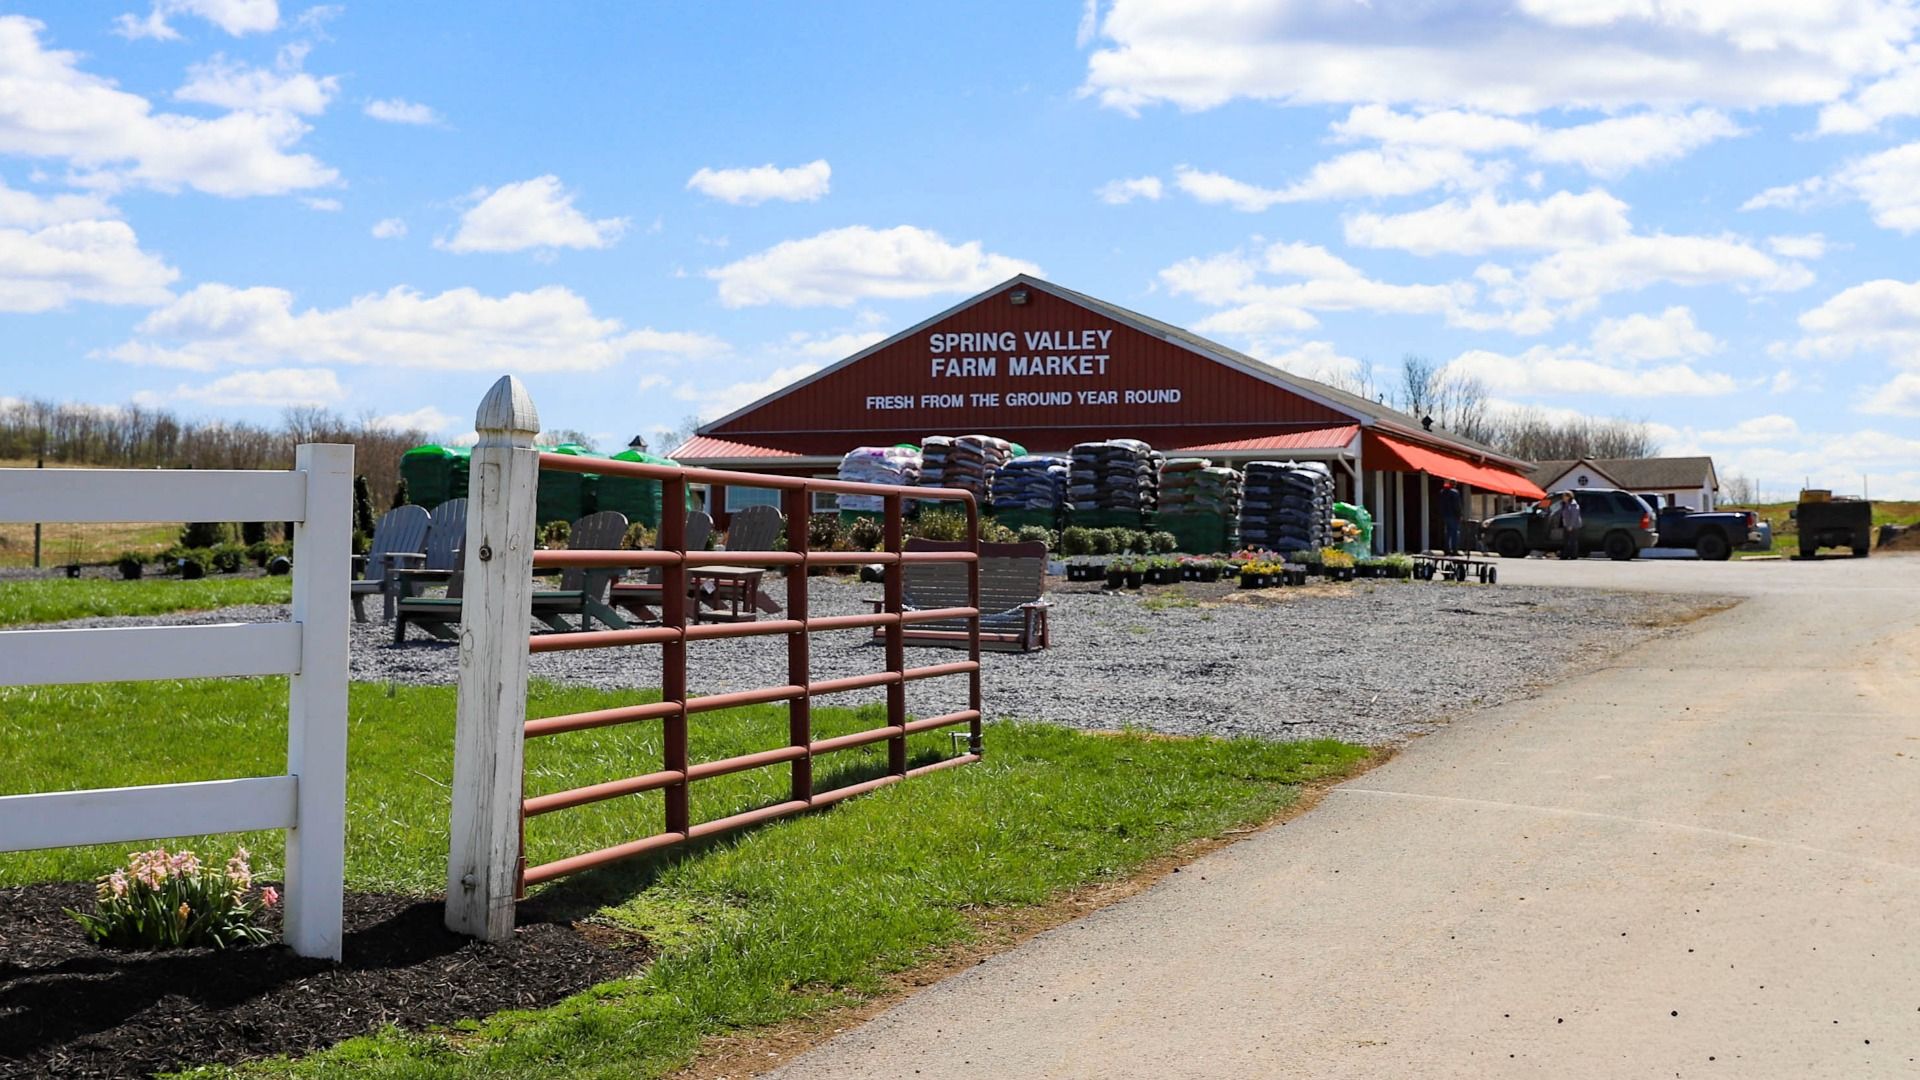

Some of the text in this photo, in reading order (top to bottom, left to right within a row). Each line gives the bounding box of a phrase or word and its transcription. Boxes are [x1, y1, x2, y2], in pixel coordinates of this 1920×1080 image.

[929, 329, 1113, 354] SPRING VALLEY
[931, 354, 1110, 378] FARM MARKET
[866, 389, 1181, 410] FRESH FROM THE GROUND YEAR ROUND
